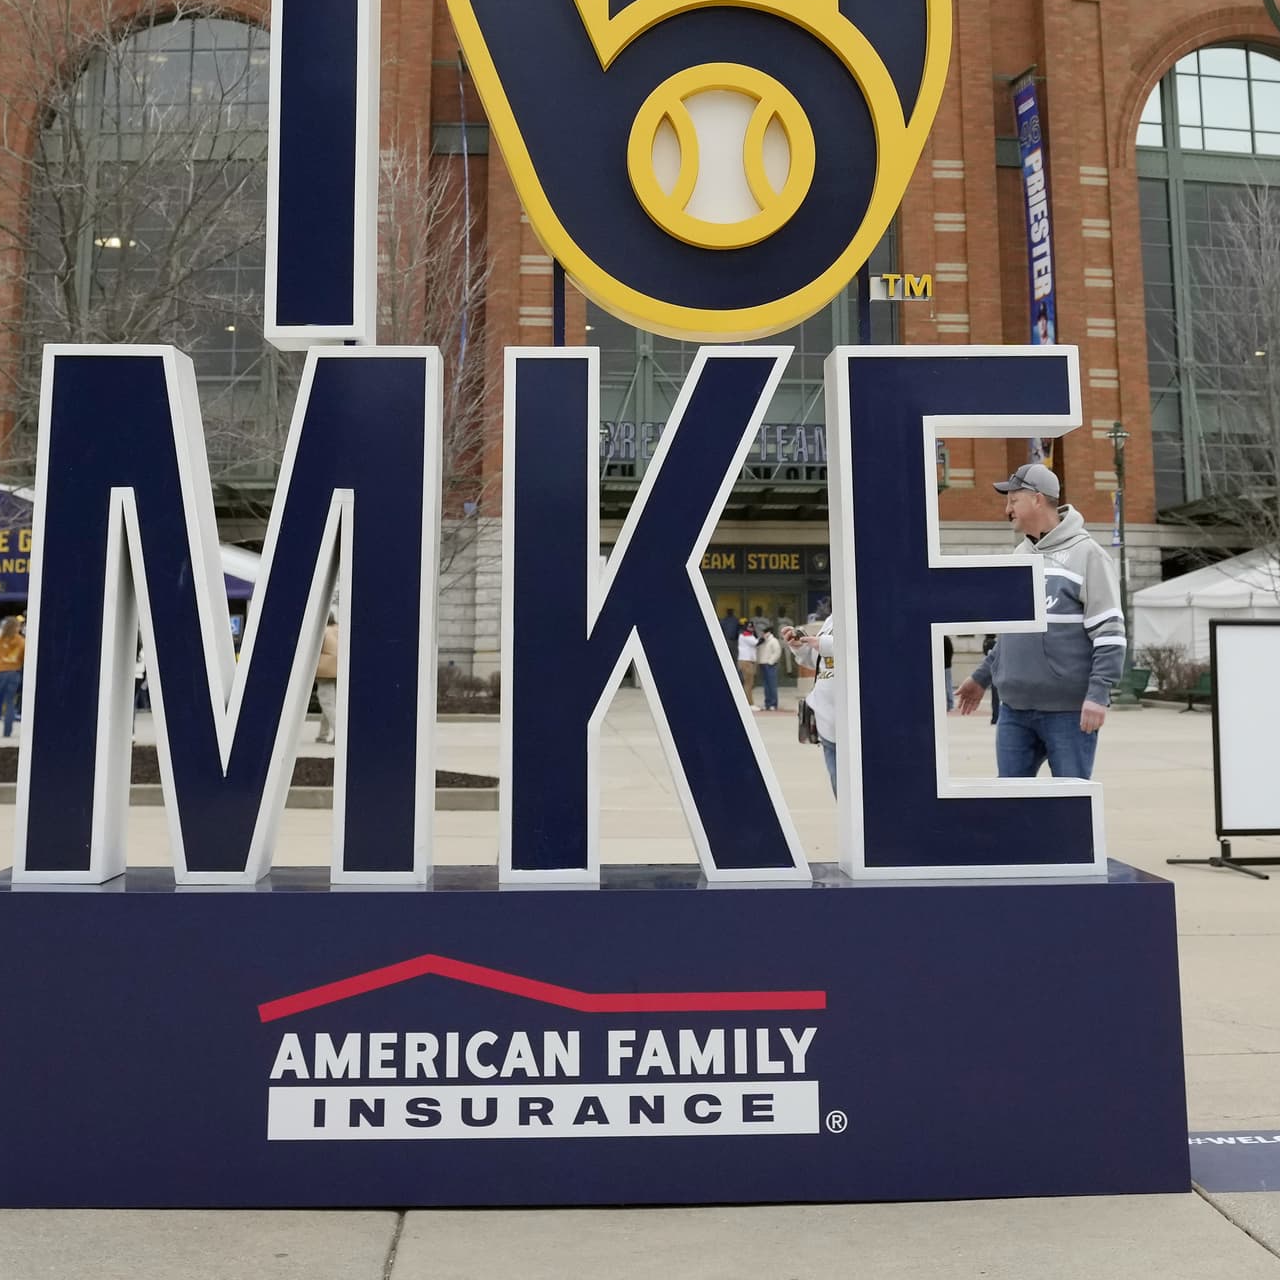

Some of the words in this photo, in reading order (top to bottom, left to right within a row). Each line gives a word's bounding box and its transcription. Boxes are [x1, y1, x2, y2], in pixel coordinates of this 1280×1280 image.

[1024, 147, 1052, 300] PRIESTER
[882, 273, 933, 299] TM
[600, 421, 665, 459] BRE
[701, 552, 737, 570] EAM
[747, 552, 801, 571] STORE
[13, 342, 1109, 889] MKE
[269, 1030, 580, 1080] AMERICAN
[607, 1027, 818, 1076] FAMILY
[313, 1093, 775, 1128] INSURANCE
